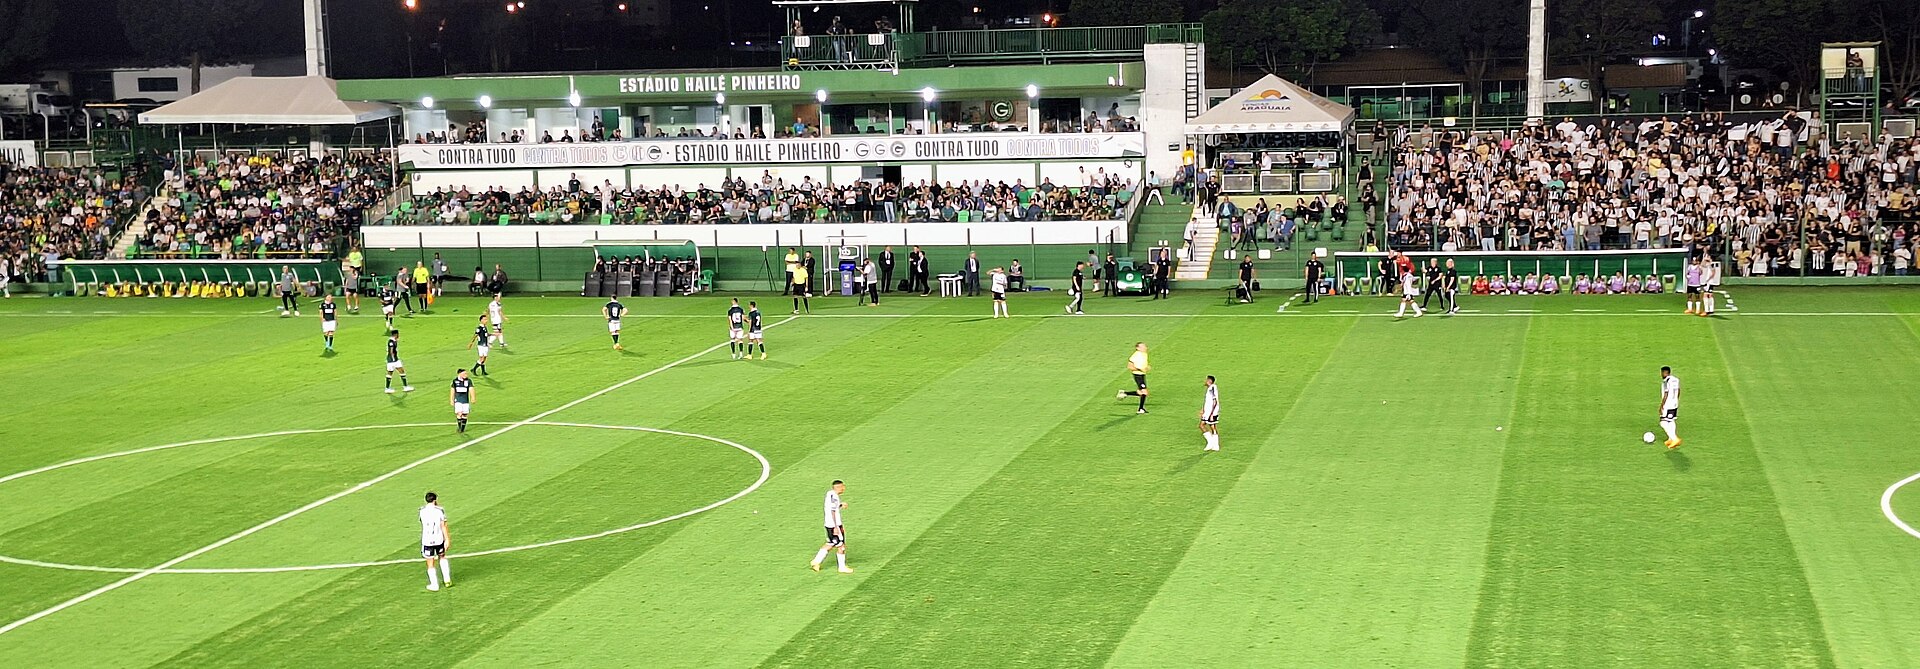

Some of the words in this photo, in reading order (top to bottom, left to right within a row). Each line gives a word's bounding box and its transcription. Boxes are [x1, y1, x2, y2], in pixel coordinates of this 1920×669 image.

[619, 75, 679, 93] ESTÁDIO
[685, 74, 726, 92] HAILÉ
[731, 74, 801, 91] PINHEIRO
[522, 147, 568, 164] CONTRA
[569, 146, 608, 164] TODOS
[778, 142, 841, 161] PINHEIRO
[915, 140, 963, 158] CONTRA
[967, 140, 999, 157] TUDO
[1006, 138, 1056, 157] CONTRA
[1058, 137, 1100, 156] TODOS
[438, 148, 484, 165] CONTRA
[486, 148, 516, 164] TUDO
